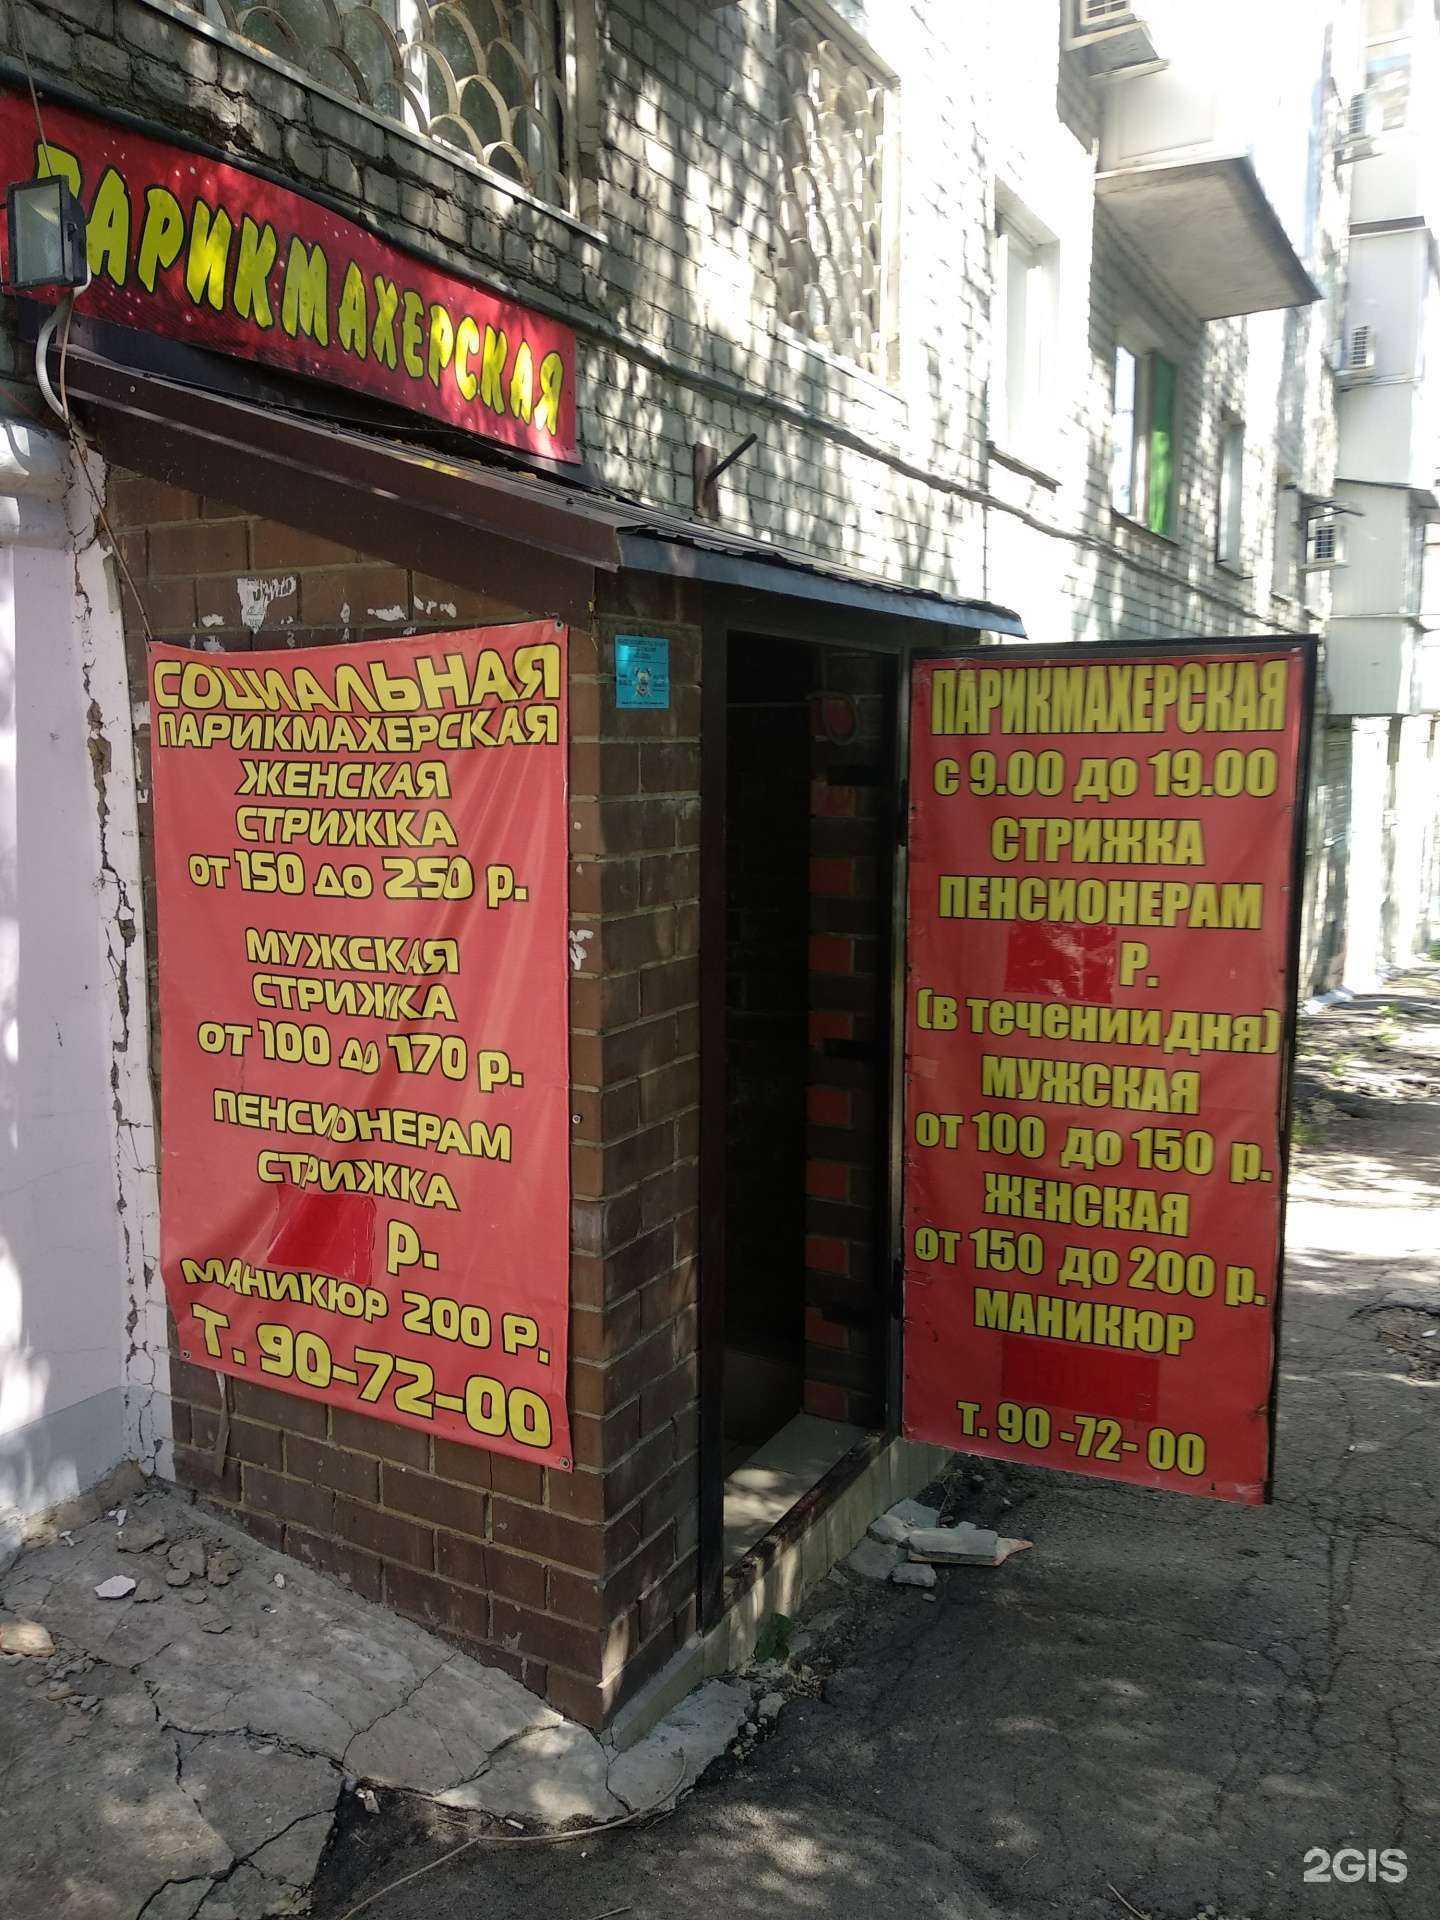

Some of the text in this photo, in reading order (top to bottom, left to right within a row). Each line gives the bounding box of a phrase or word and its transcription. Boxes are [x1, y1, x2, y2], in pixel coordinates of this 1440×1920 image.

[153, 643, 560, 713] СОЦИАЛЬНАЯ
[931, 660, 1289, 735] ПАРИКМАХЕРСКАЯ
[157, 703, 560, 752] ПАРИКМАХЕРСКАЯ
[235, 759, 451, 799] ЖЕНСКАЯ
[969, 749, 1065, 797] 9.00
[1072, 757, 1139, 803] до
[1147, 749, 1278, 798] 19.00
[236, 806, 458, 848] СТРИЖКА
[991, 817, 1206, 866] СТРИЖКА
[234, 849, 305, 896] 150
[382, 855, 474, 901] 250
[938, 875, 1263, 930] ПЕНСИОНЕРАМ
[245, 927, 460, 975] МУЖСКАЯ
[252, 972, 458, 1023] СТРИЖКА
[966, 997, 1161, 1047] течении
[1163, 1009, 1281, 1055] дня)
[257, 1018, 331, 1066] 100
[387, 1033, 468, 1081] 170
[981, 1055, 1200, 1115] МУЖСКАЯ
[213, 1088, 512, 1163] ПЕНСИОНЕРАМ
[915, 1112, 1273, 1184] от 100 до 150 р.
[257, 1149, 461, 1212] СТРИЖКА
[984, 1172, 1190, 1238] ЖЕНСКАЯ
[914, 1227, 1268, 1307] от 150 до 200 р.
[180, 1259, 389, 1323] МАНИКЮР
[402, 1292, 492, 1349] 200
[973, 1287, 1195, 1356] МАНИКЮР
[256, 1323, 553, 1448] 90-72-00
